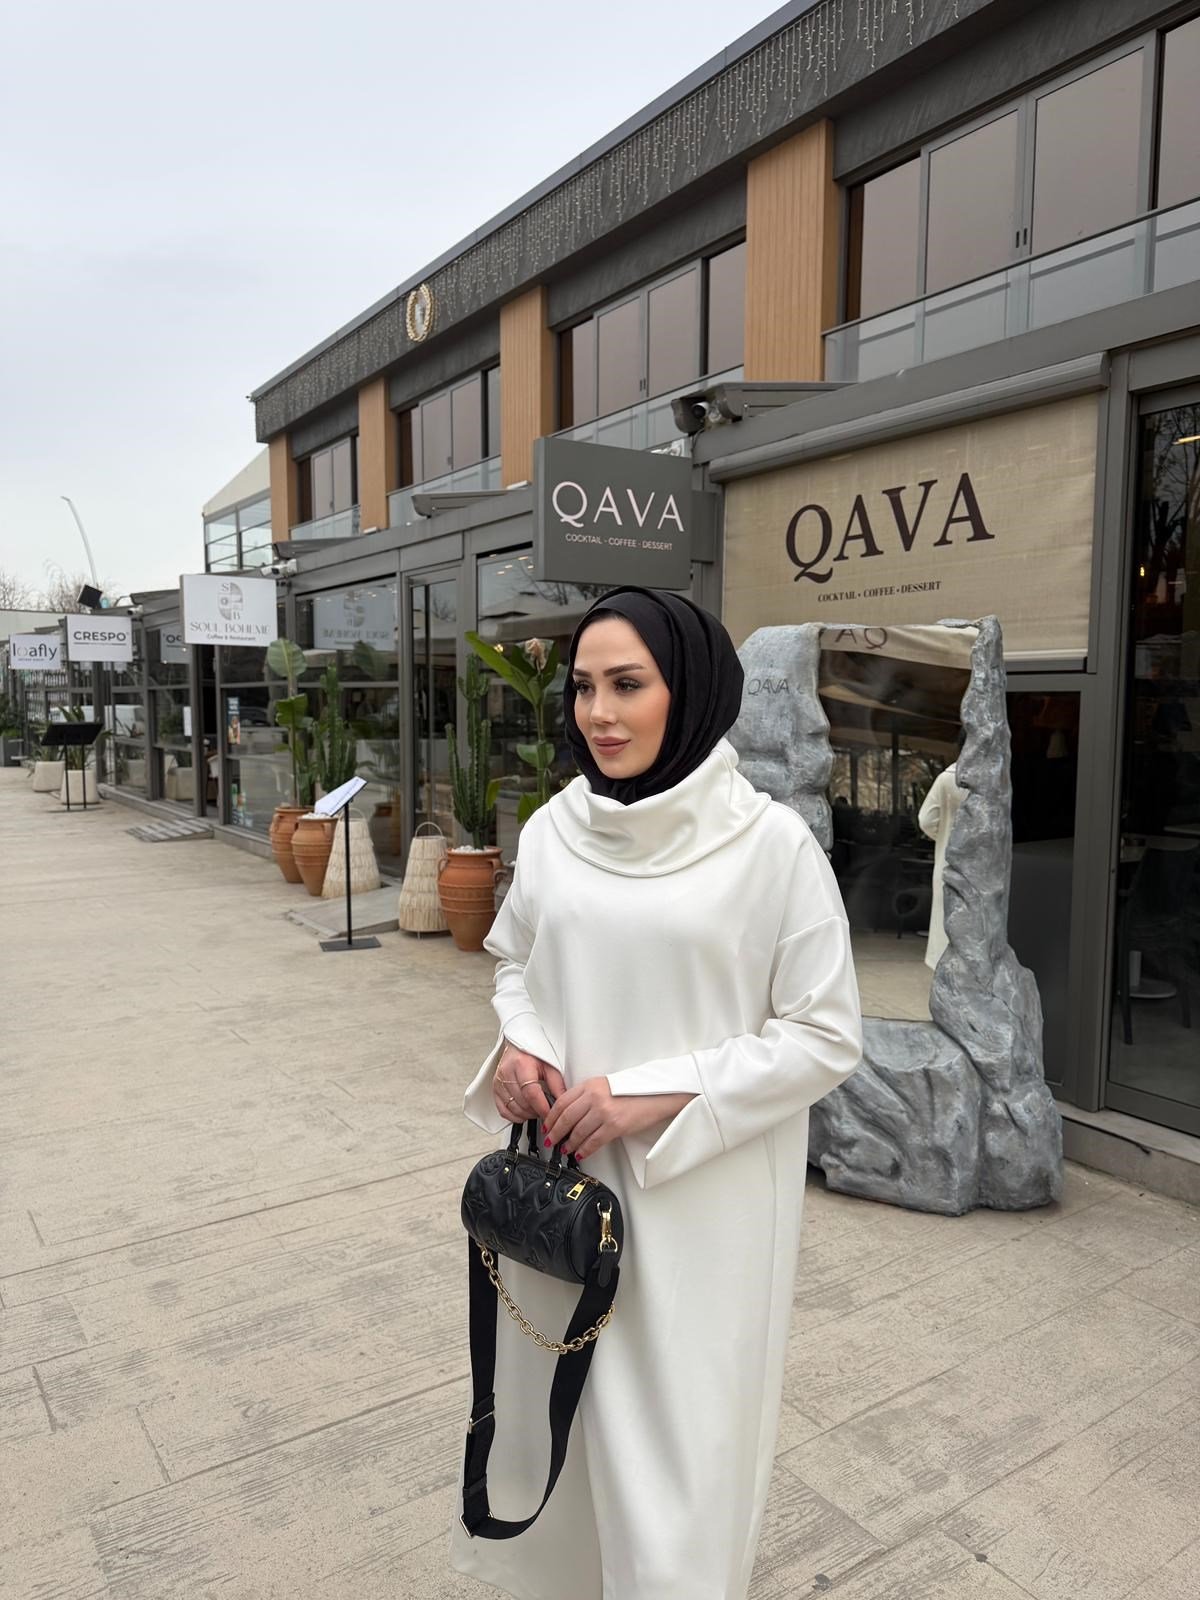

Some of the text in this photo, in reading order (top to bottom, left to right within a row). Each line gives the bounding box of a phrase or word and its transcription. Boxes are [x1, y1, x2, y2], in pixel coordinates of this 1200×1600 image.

[552, 481, 684, 532] QAVA
[785, 472, 995, 584] QAVA
[565, 533, 673, 551] COCKTAIL COFFEE DESSERT
[818, 581, 942, 602] COCKTAIL COFFEE DESSERT
[73, 631, 127, 642] CRESPO
[12, 643, 58, 660] loafly
[747, 678, 790, 696] QAVA
